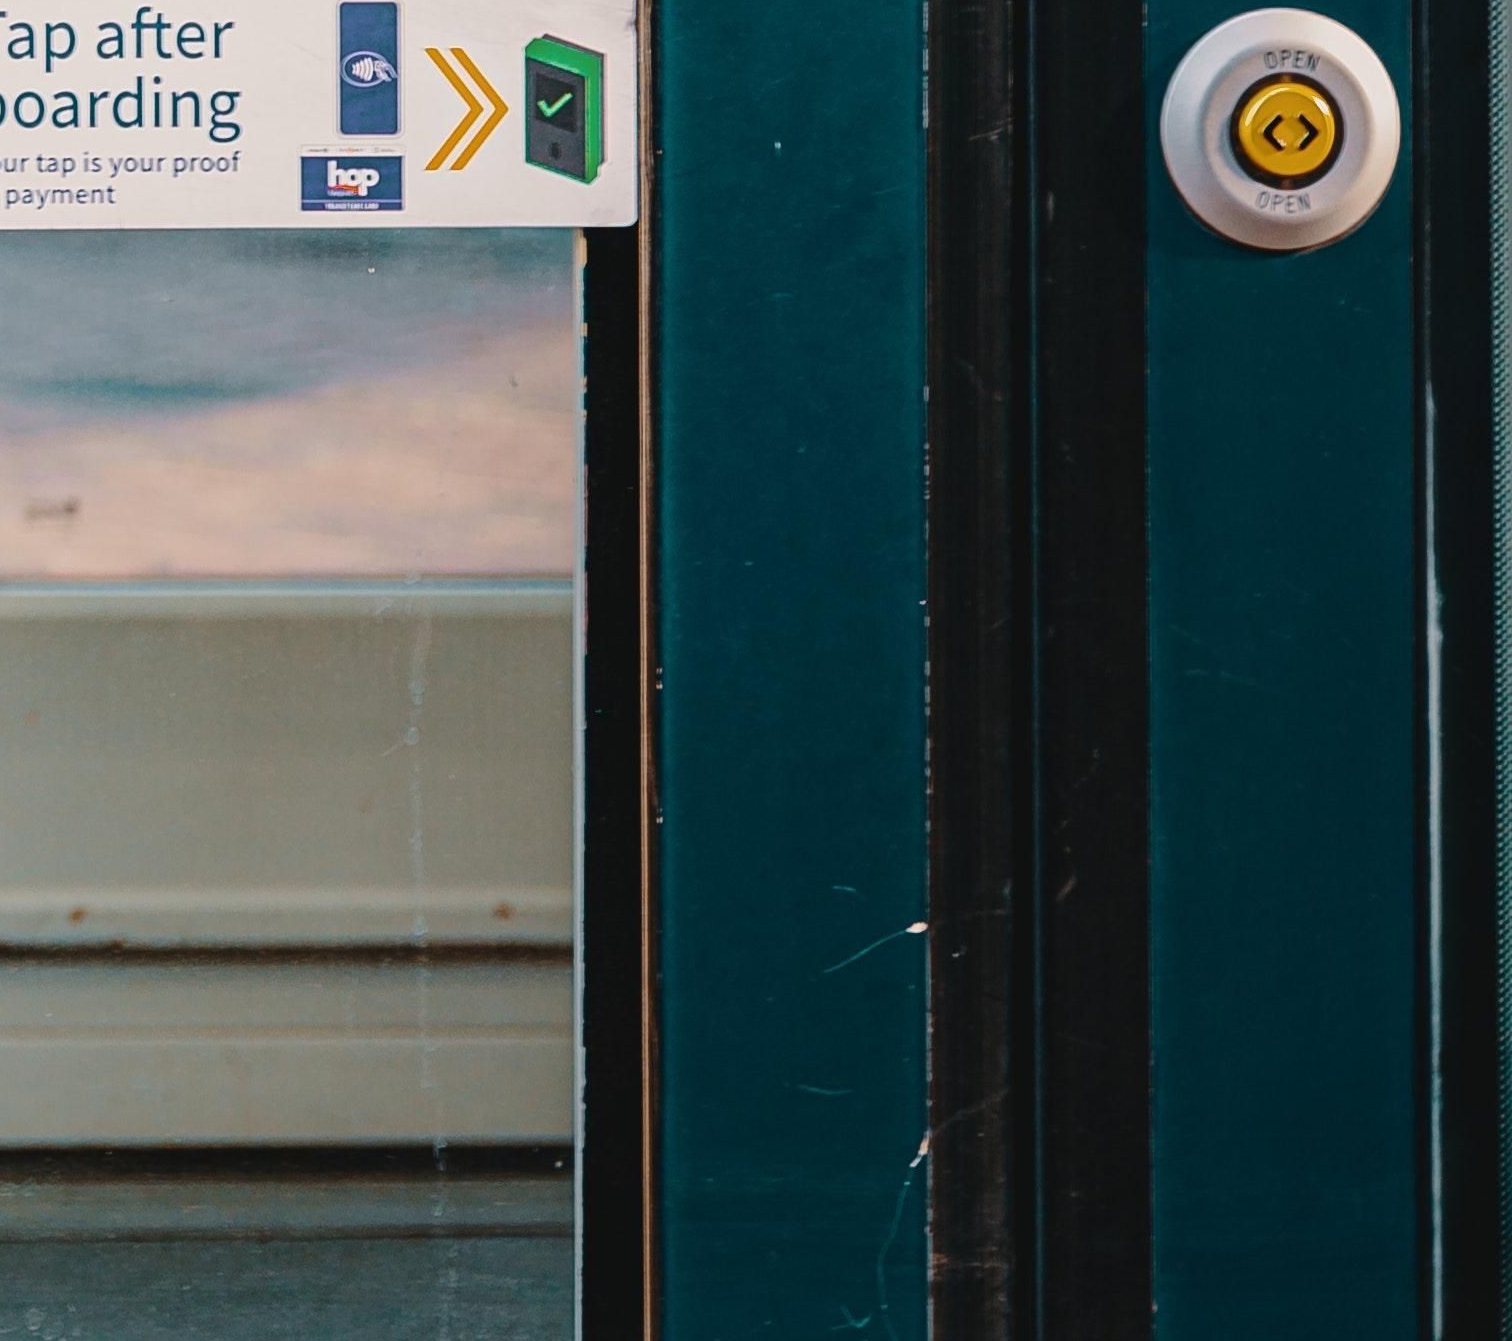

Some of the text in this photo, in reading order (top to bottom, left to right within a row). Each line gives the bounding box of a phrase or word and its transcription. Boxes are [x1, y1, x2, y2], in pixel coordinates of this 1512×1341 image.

[97, 7, 234, 59] after
[1266, 49, 1320, 71] OPEN
[36, 156, 75, 177] tap
[85, 152, 101, 172] is
[110, 157, 166, 178] your
[174, 151, 240, 177] proof
[327, 160, 380, 196] hop
[7, 187, 115, 209] payment
[1257, 191, 1311, 214] OPEN
